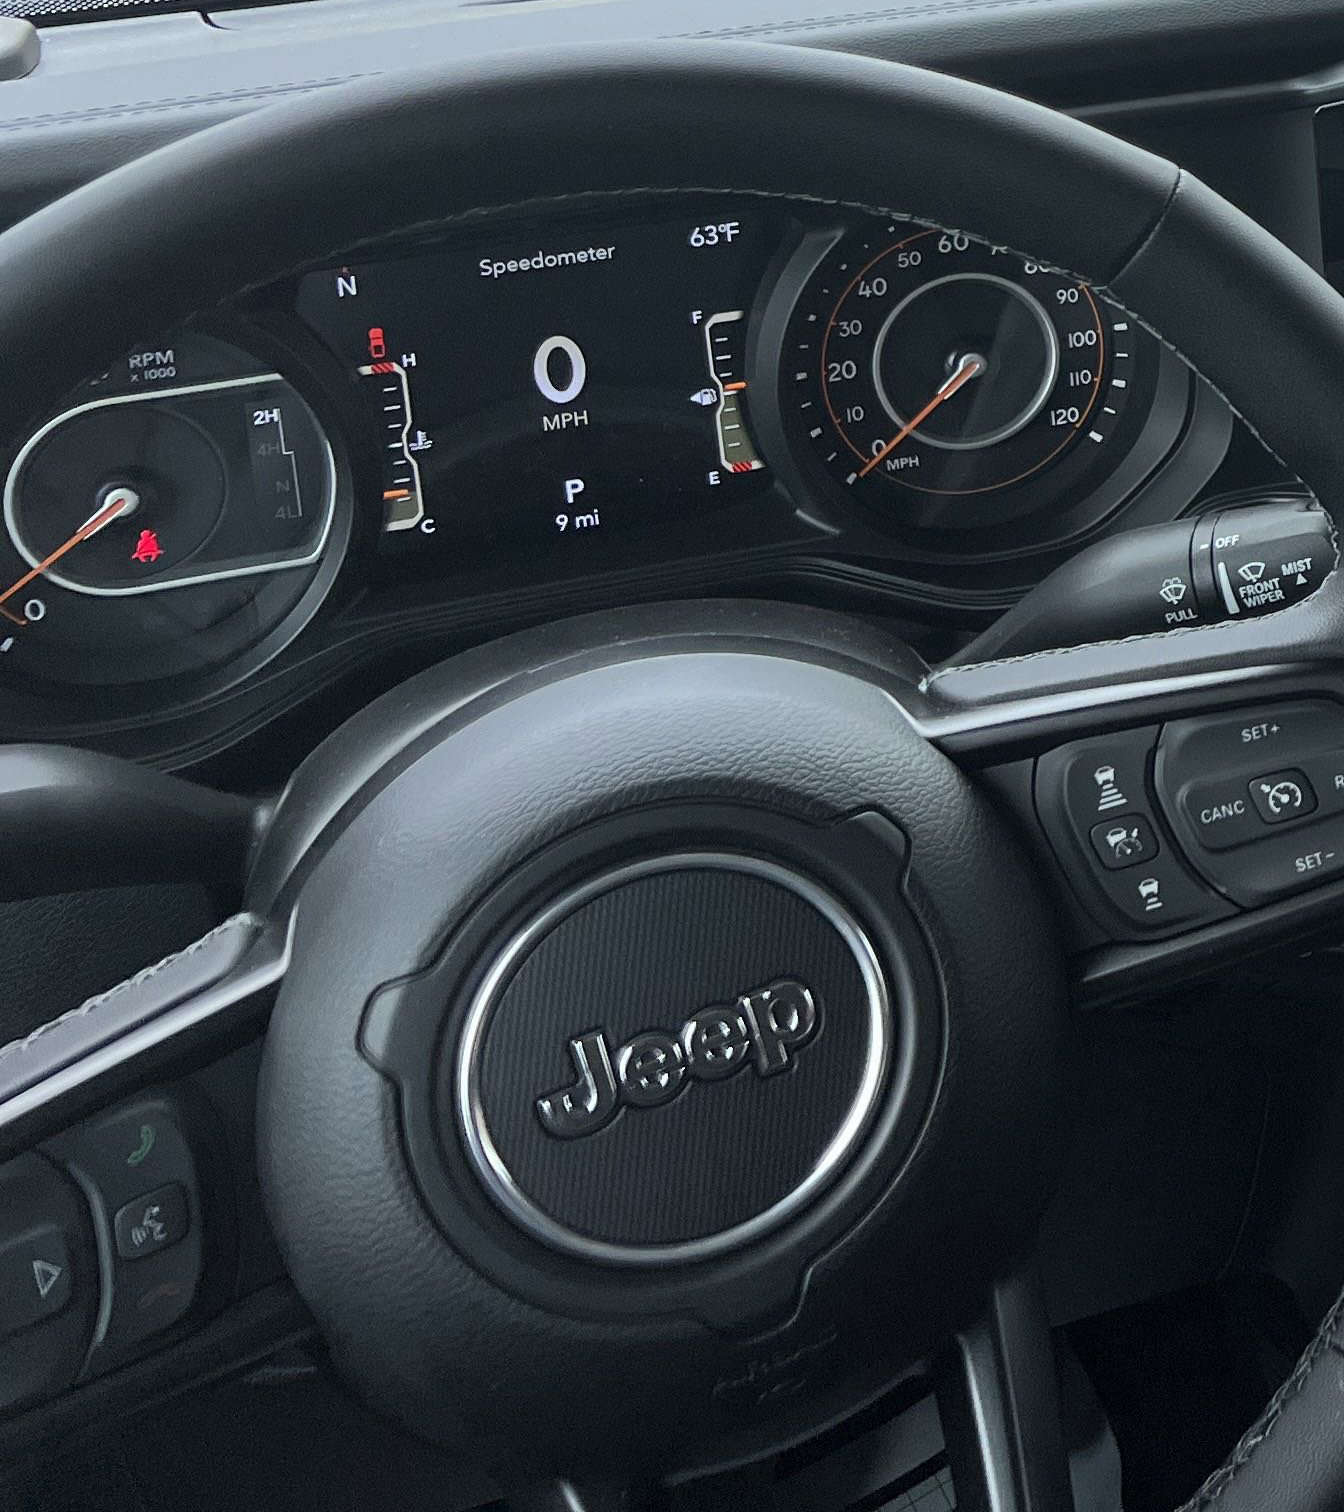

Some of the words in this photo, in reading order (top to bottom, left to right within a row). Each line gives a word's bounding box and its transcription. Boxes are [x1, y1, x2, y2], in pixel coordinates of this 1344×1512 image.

[689, 221, 742, 248] 63°F
[938, 233, 970, 254] 60
[479, 244, 616, 278] Speedometer
[897, 250, 922, 268] 50
[336, 276, 358, 298] N
[858, 277, 888, 299] 40
[1056, 288, 1080, 304] 90
[691, 310, 703, 325] F
[839, 319, 864, 338] 30
[1067, 330, 1097, 348] 100
[128, 349, 175, 370] RPM
[402, 352, 417, 368] H
[533, 335, 587, 404] 0
[144, 366, 177, 381] 1000
[827, 361, 857, 382] 20
[1069, 369, 1092, 387] 110
[253, 408, 279, 426] 2H
[542, 410, 589, 432] MPH
[846, 406, 865, 424] 10
[1050, 407, 1081, 427] 120
[886, 455, 920, 472] MPH
[708, 471, 721, 487] E
[565, 478, 585, 504] P
[420, 518, 436, 535] C
[555, 514, 569, 532] 9
[575, 509, 600, 527] mi
[1215, 534, 1240, 550] OFF
[1280, 557, 1313, 577] MIST
[1239, 577, 1281, 599] FRONT
[1243, 589, 1285, 609] WIPER
[24, 599, 46, 621] 0
[1165, 607, 1198, 624] PULL
[1241, 722, 1280, 743] SET+
[1200, 800, 1246, 824] CANC
[536, 978, 825, 1138] Jeep
